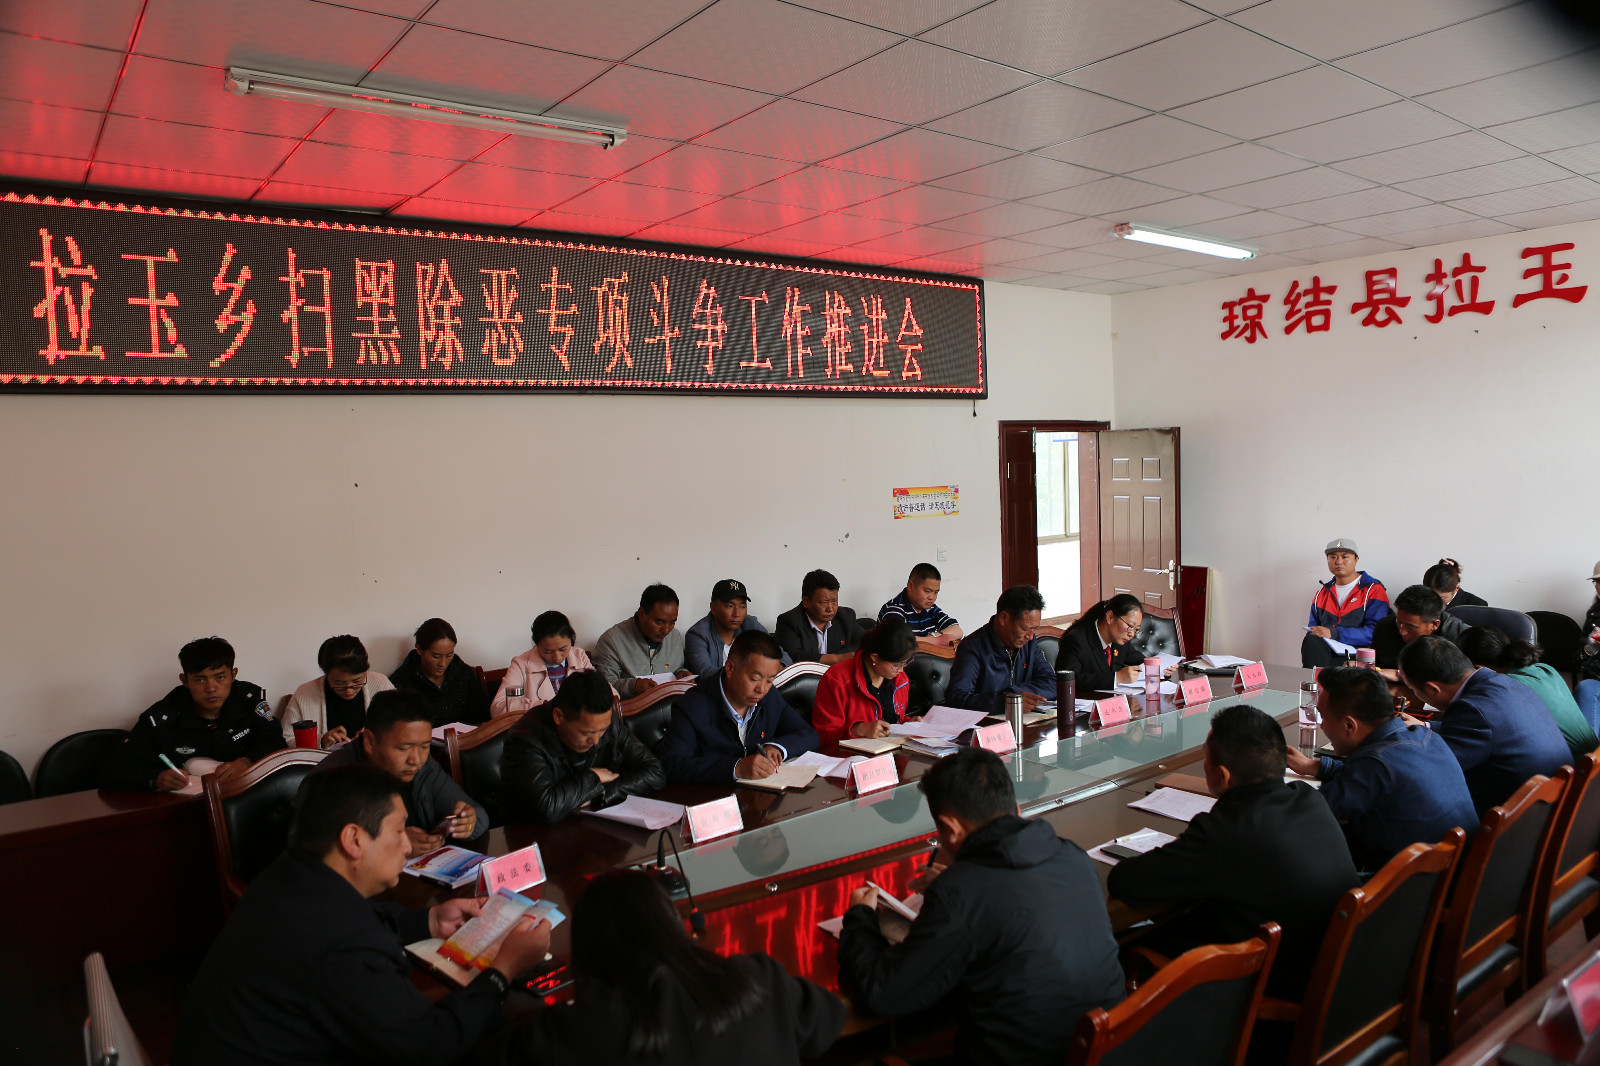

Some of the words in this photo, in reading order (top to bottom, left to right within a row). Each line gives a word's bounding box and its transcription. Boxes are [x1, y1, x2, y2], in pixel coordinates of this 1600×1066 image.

[30, 228, 923, 381] 拉玉乡扫黑除恶专项斗争工作推进会
[1220, 242, 1588, 343] 琼结县拉玉
